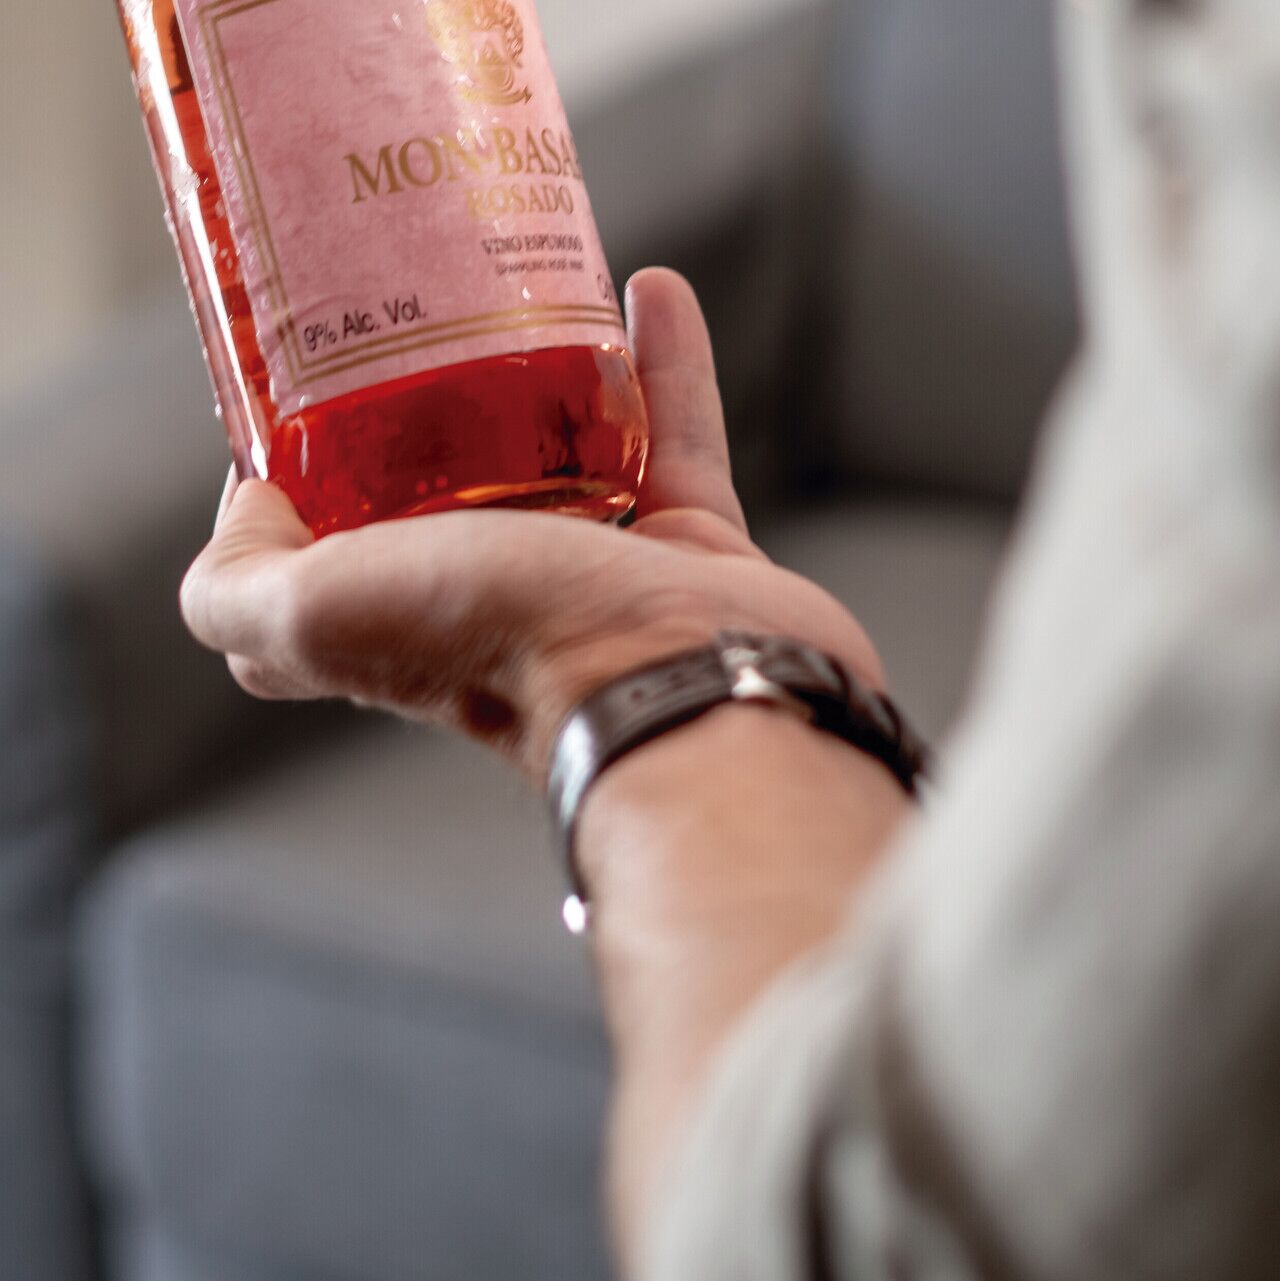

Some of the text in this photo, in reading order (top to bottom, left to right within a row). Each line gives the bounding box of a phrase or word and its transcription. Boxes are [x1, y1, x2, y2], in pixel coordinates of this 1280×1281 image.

[465, 184, 575, 219] ROSADO
[303, 293, 428, 353] 9% Alc. Vol.
